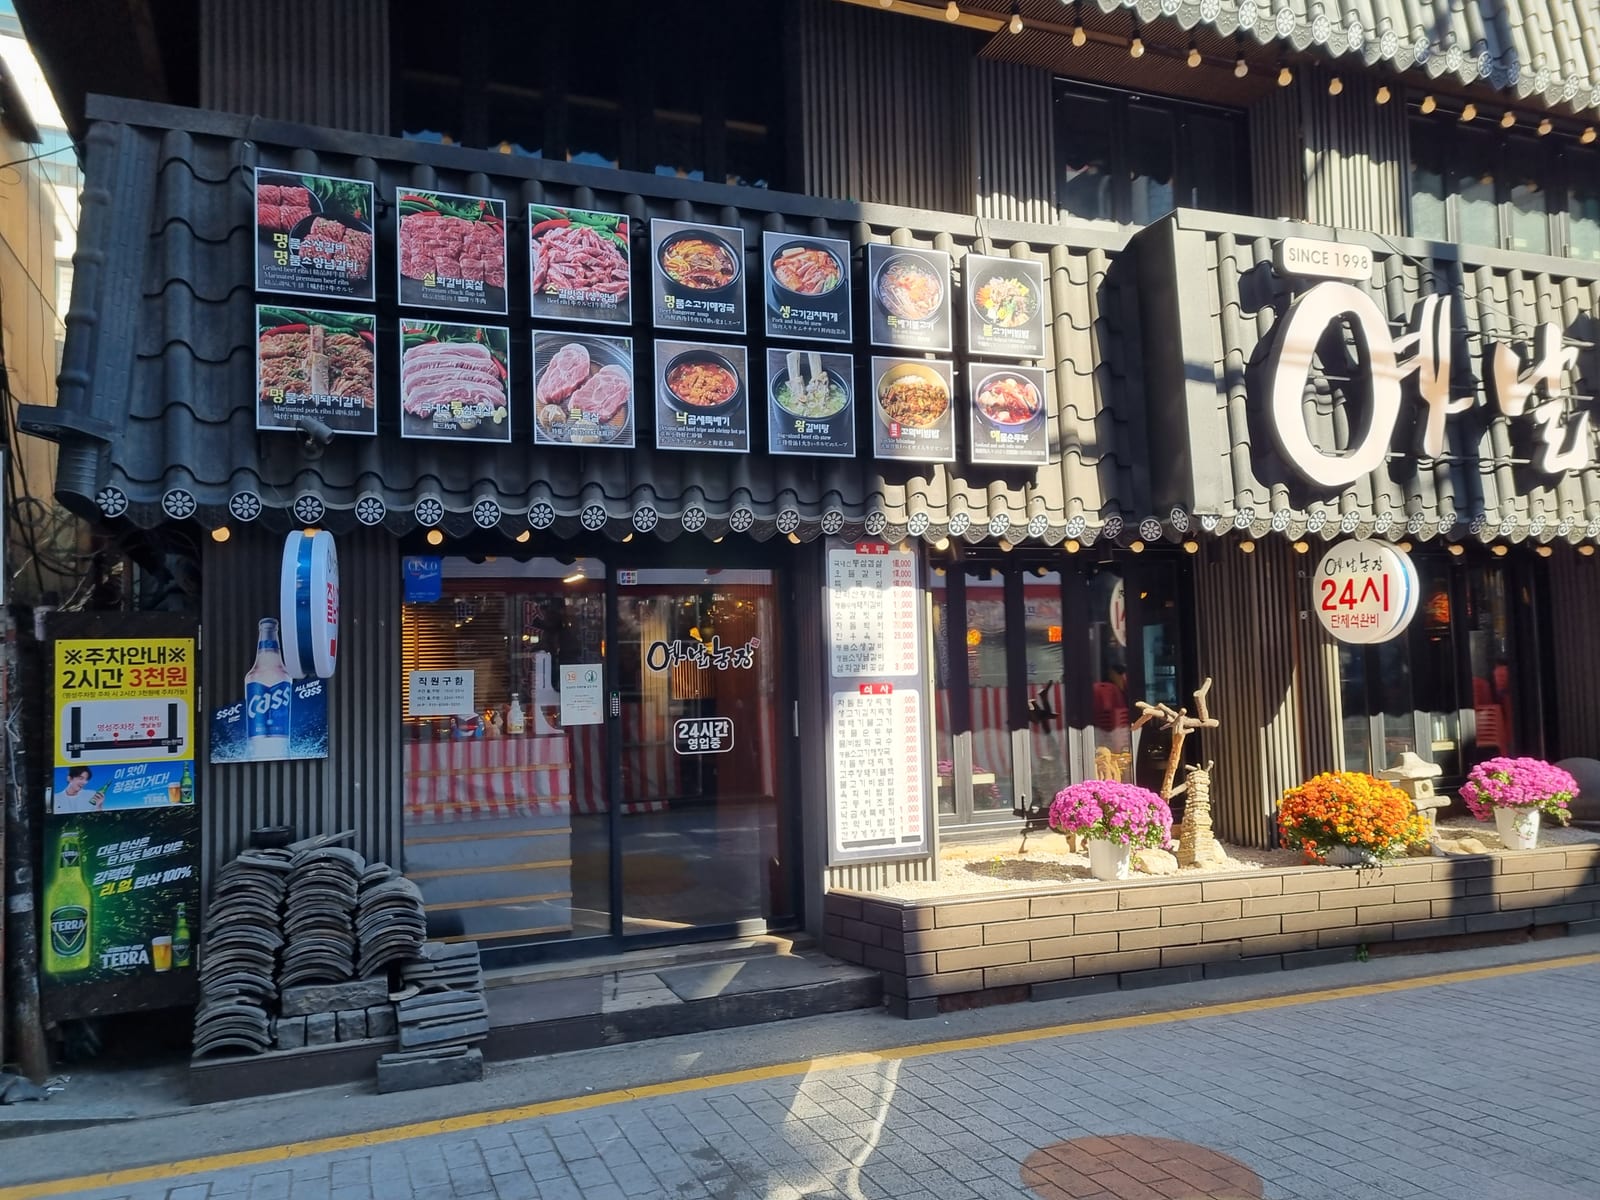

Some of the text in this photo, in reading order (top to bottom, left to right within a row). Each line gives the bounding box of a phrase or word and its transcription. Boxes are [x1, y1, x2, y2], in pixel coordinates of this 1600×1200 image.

[273, 233, 347, 254] 명품소생갈비
[1288, 247, 1369, 270] SINCE 1998
[779, 305, 839, 322] 생고기김치찌개
[1324, 551, 1384, 577] 옛날농장
[1320, 574, 1389, 613] 24시
[1331, 613, 1380, 629] 단체석완비
[646, 635, 754, 672] 옛날농장
[62, 666, 188, 689] 2시간 3천원
[678, 722, 730, 739] 24시간
[687, 738, 722, 750] 영업중
[114, 763, 148, 779] 이 맛이
[52, 919, 85, 931] TERRA
[101, 949, 150, 969] TERRA
